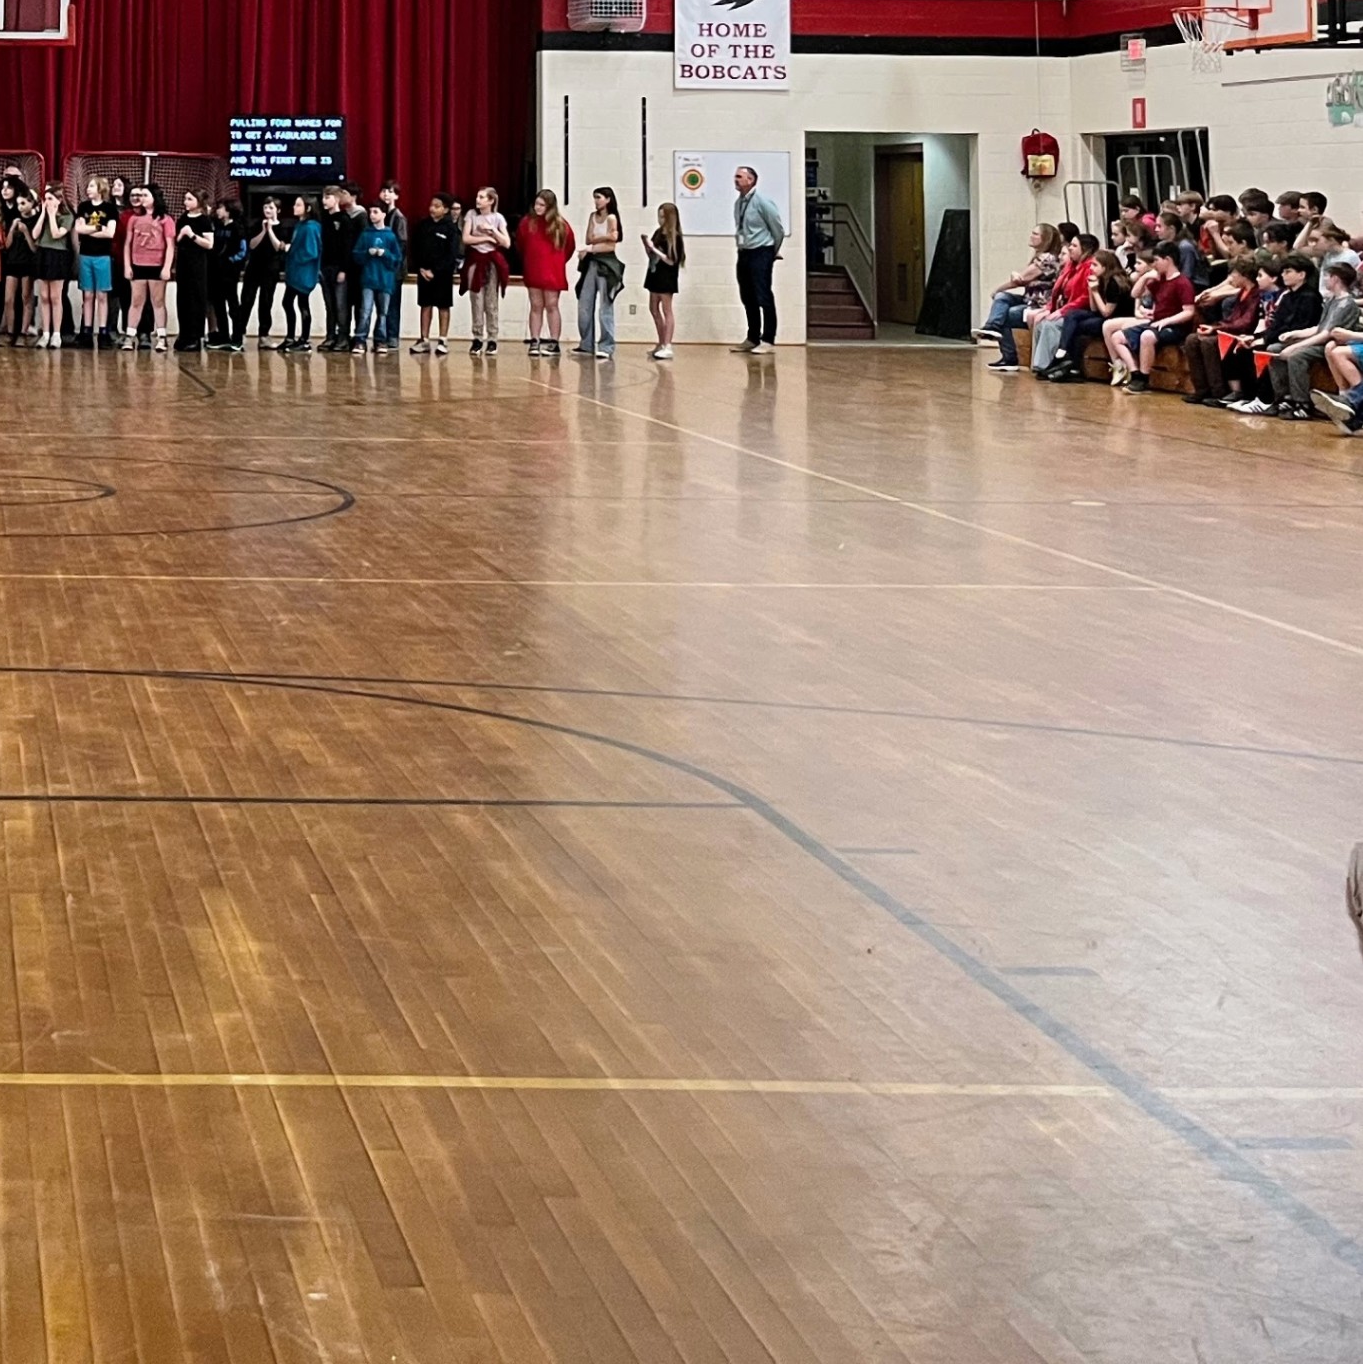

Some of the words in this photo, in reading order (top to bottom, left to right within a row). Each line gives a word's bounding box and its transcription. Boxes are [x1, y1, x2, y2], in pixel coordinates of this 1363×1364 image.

[697, 22, 767, 38] HOME
[690, 43, 720, 58] OF
[727, 43, 776, 59] THE
[679, 64, 787, 80] BOBCATS
[230, 118, 267, 127] PULLING
[270, 118, 292, 127] FOUR
[295, 119, 322, 127] NAMES
[325, 119, 342, 127] FOR
[230, 131, 242, 139] TO
[245, 131, 262, 139] GET
[265, 131, 272, 139] A
[275, 131, 317, 140] FABULOUS
[230, 156, 247, 164] AND
[251, 156, 267, 164] THE
[270, 156, 296, 164] FIRST
[300, 156, 317, 164] ONE
[320, 156, 332, 164] IS
[230, 168, 271, 177] ACTUALLY
